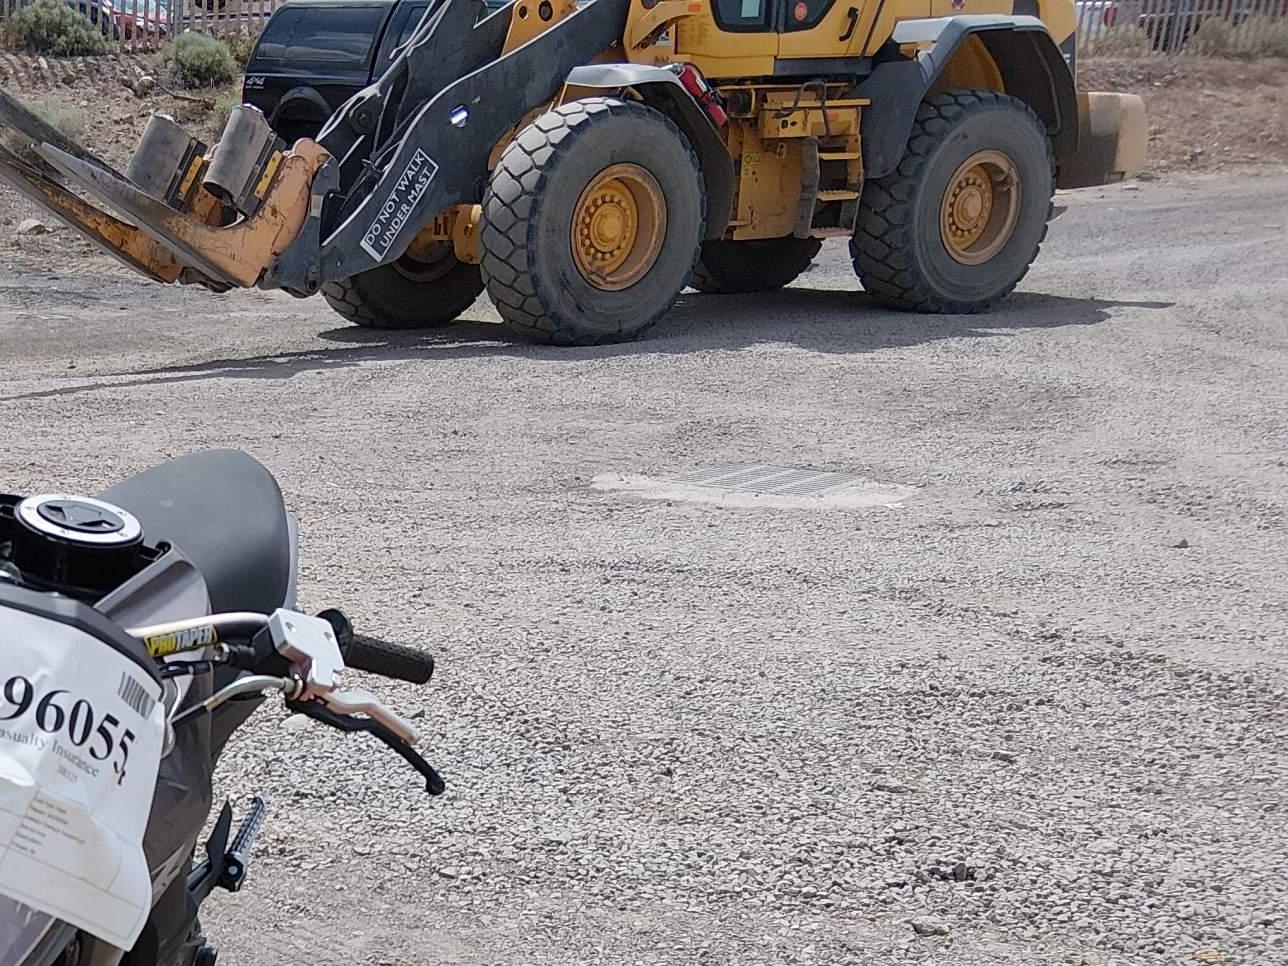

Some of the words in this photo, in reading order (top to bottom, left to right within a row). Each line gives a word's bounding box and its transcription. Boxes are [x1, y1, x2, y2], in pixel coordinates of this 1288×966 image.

[365, 224, 382, 246] DO
[381, 192, 400, 223] NOT
[398, 154, 425, 192] WALK
[379, 203, 411, 247] UNDER
[407, 166, 432, 204] MAST
[51, 740, 100, 778] Insurance
